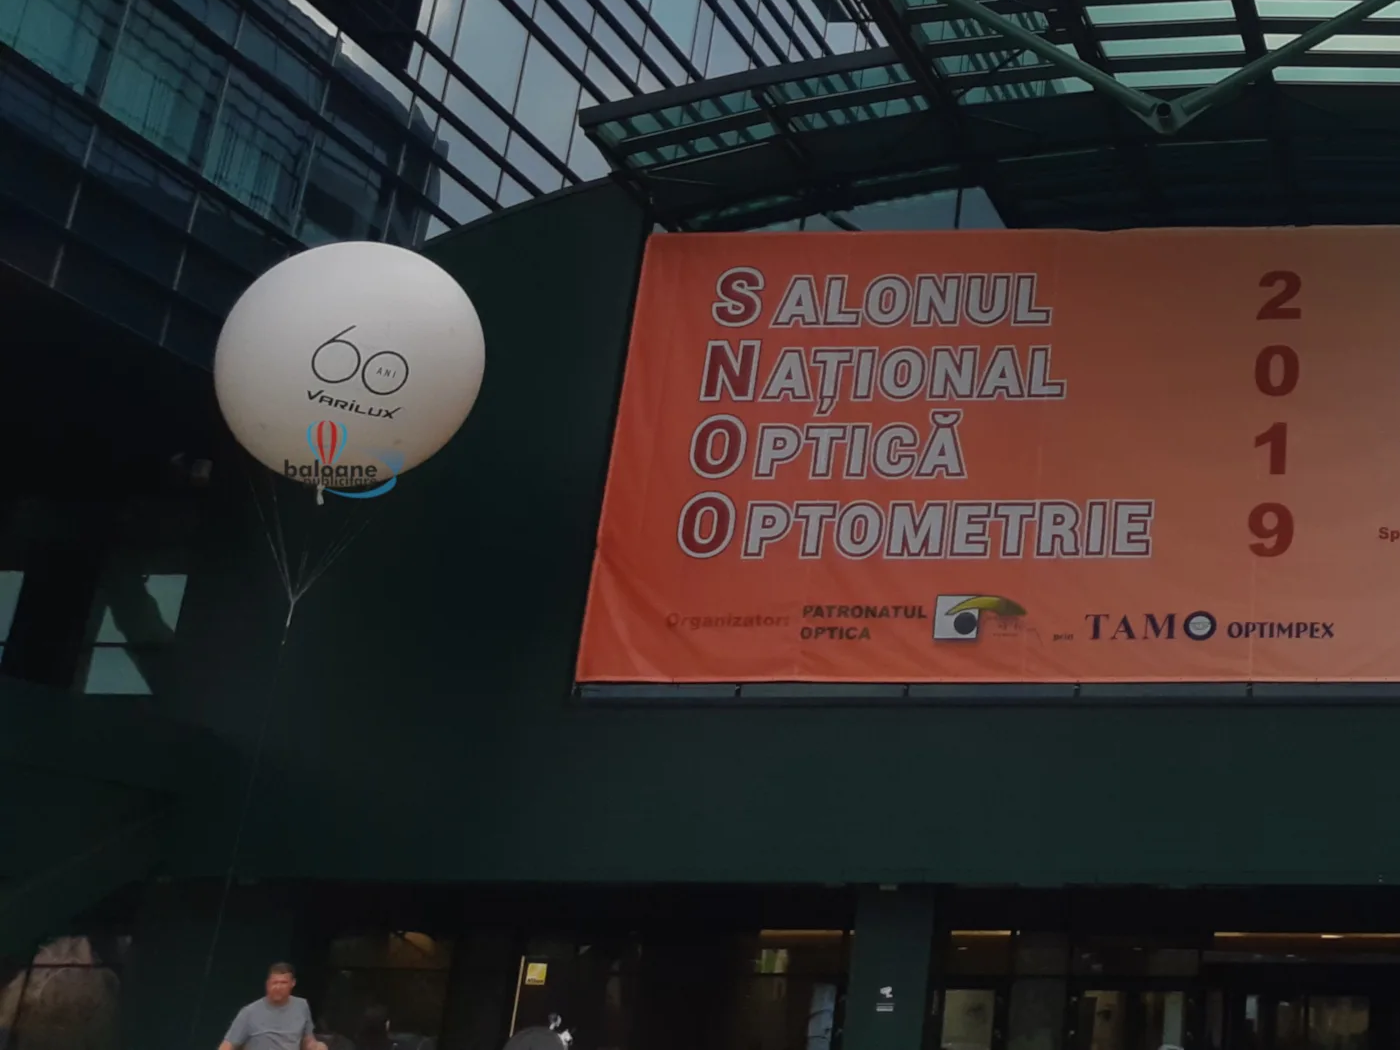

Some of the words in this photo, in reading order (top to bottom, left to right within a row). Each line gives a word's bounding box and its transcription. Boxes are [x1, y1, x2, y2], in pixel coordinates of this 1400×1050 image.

[712, 266, 1053, 327] SALONUL
[311, 325, 409, 395] 60
[376, 366, 397, 379] ANI
[690, 409, 968, 479] OPTICĂ
[677, 490, 1155, 559] OPTOMETRIE
[802, 605, 927, 619] PATRONATUL
[1226, 620, 1334, 640] OPTIMPEX
[800, 626, 871, 640] OPTICA
